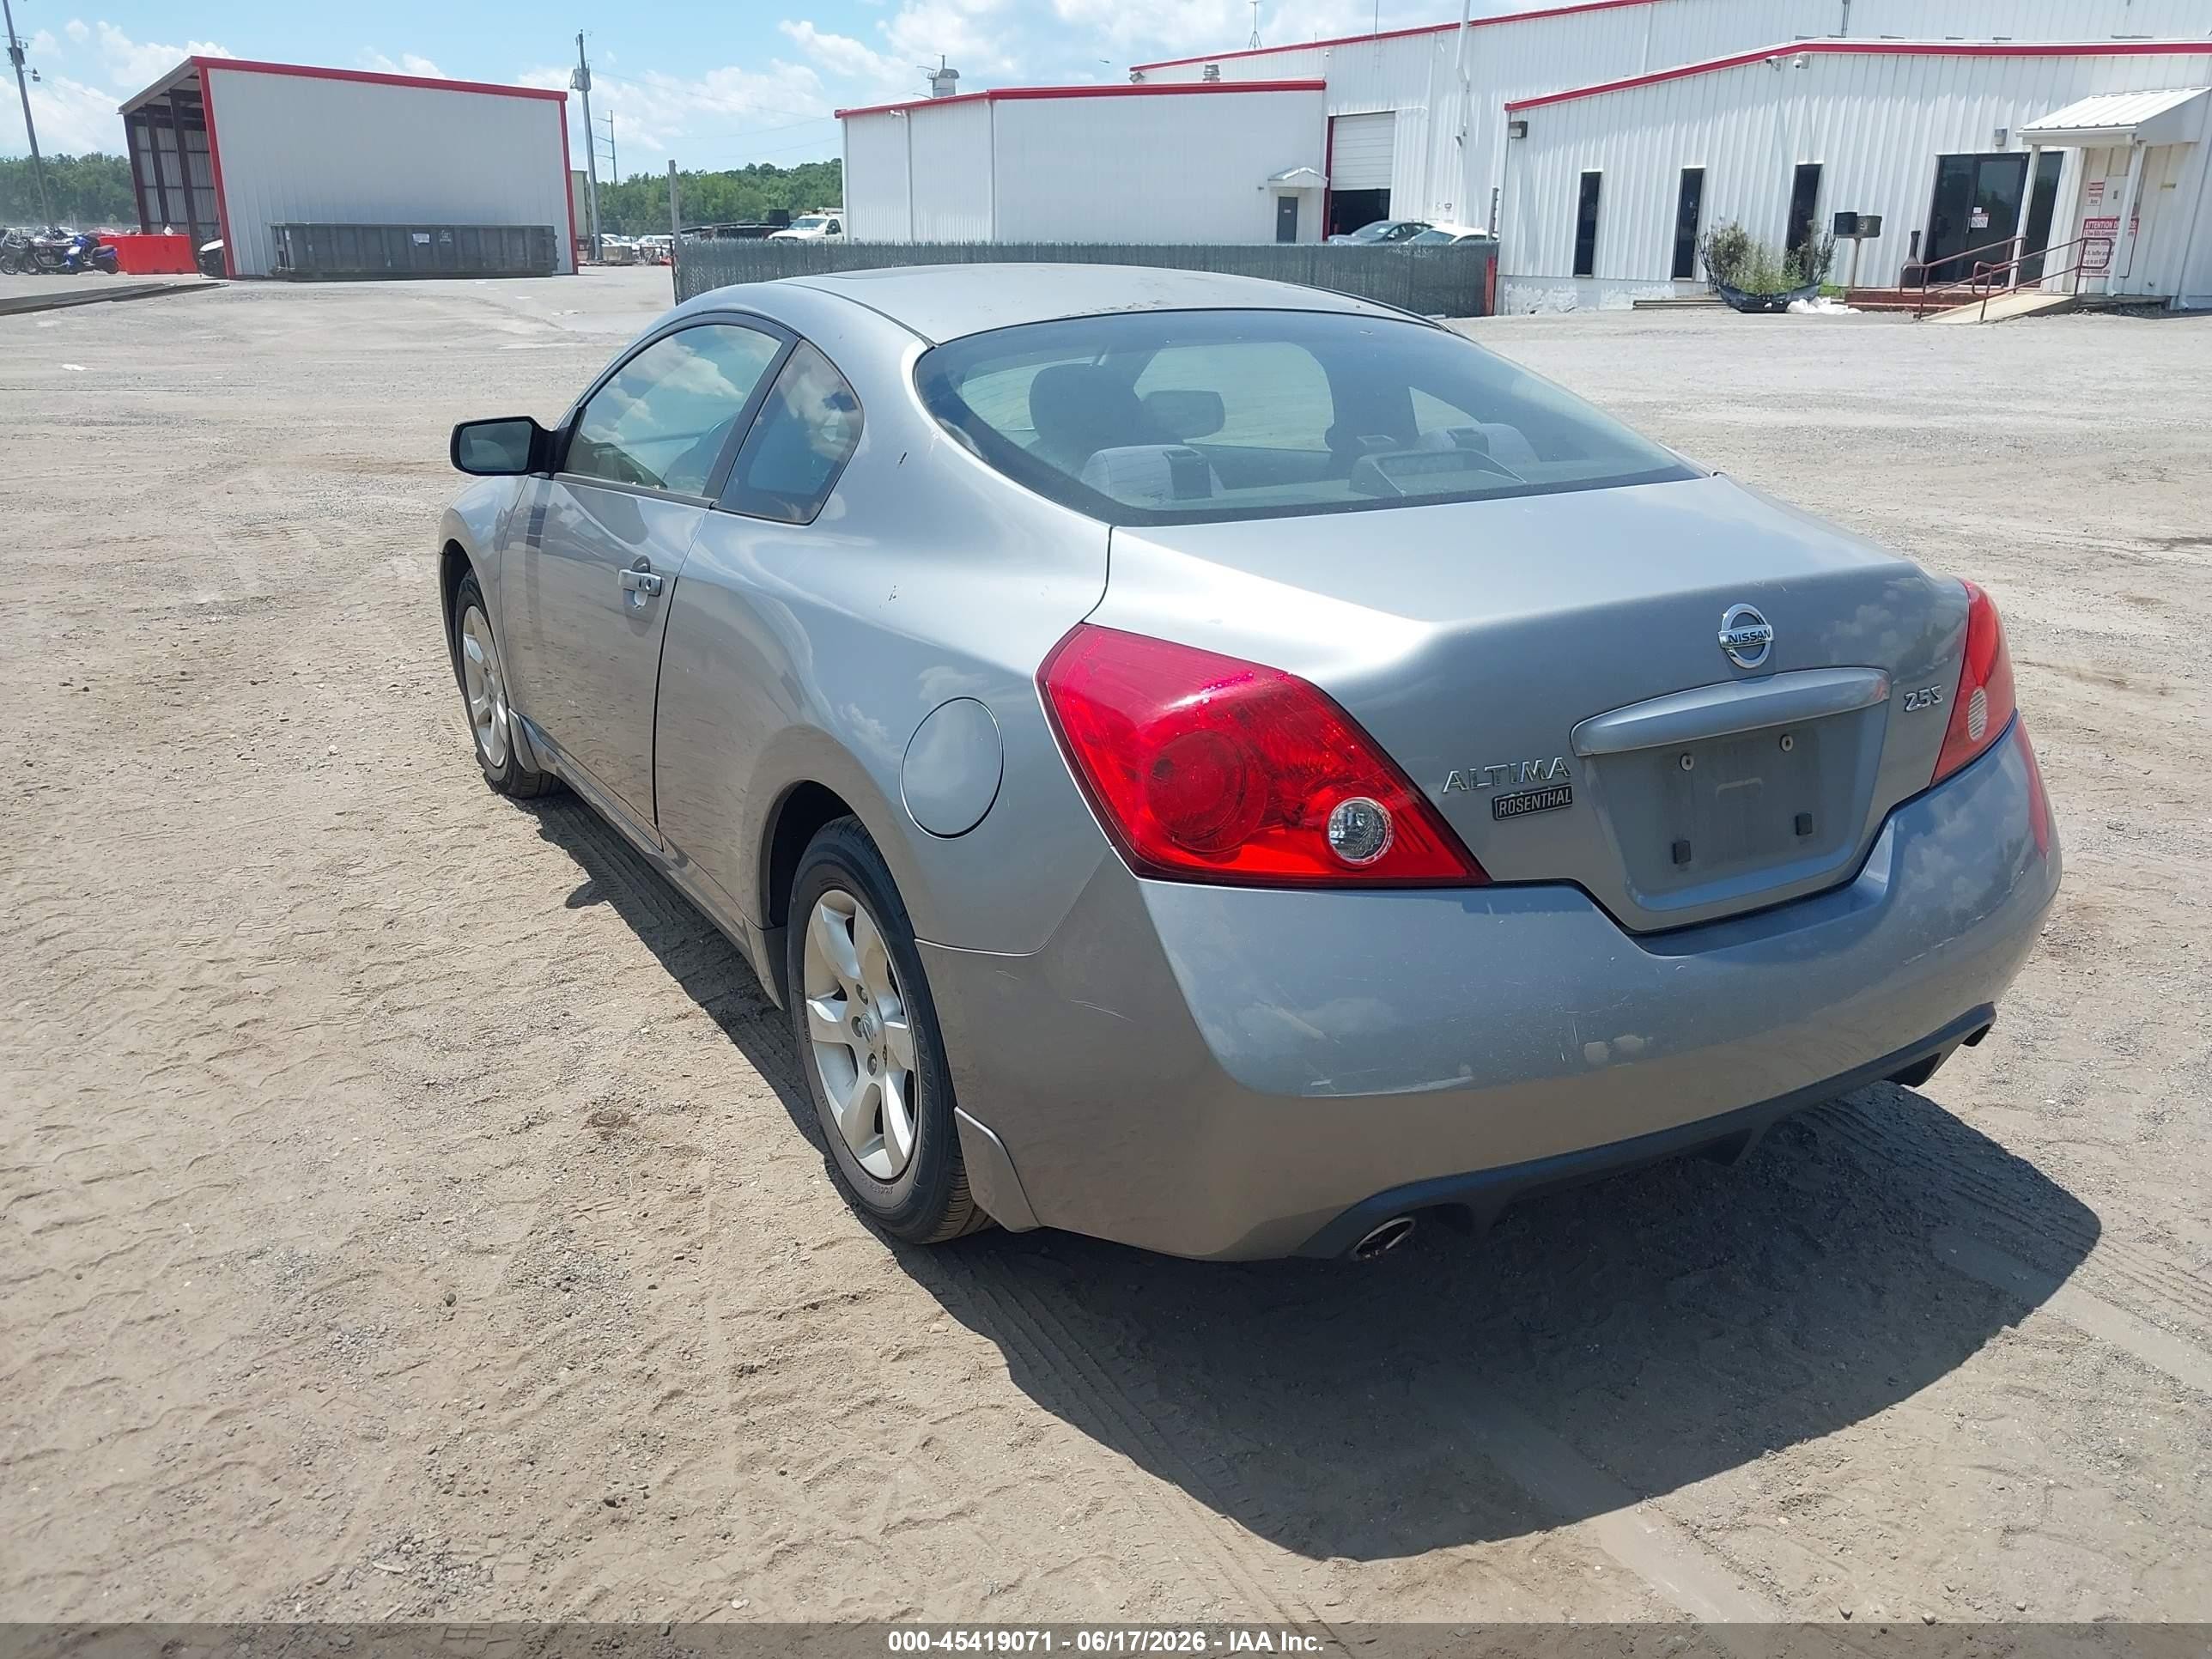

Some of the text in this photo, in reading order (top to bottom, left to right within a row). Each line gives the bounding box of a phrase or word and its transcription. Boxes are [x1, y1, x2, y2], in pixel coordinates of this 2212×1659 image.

[2085, 220, 2114, 229] ATTENTION
[1728, 629, 1771, 643] NISSAN
[1443, 757, 1573, 793] ALTIMA
[1498, 788, 1572, 817] ROSENTHAL
